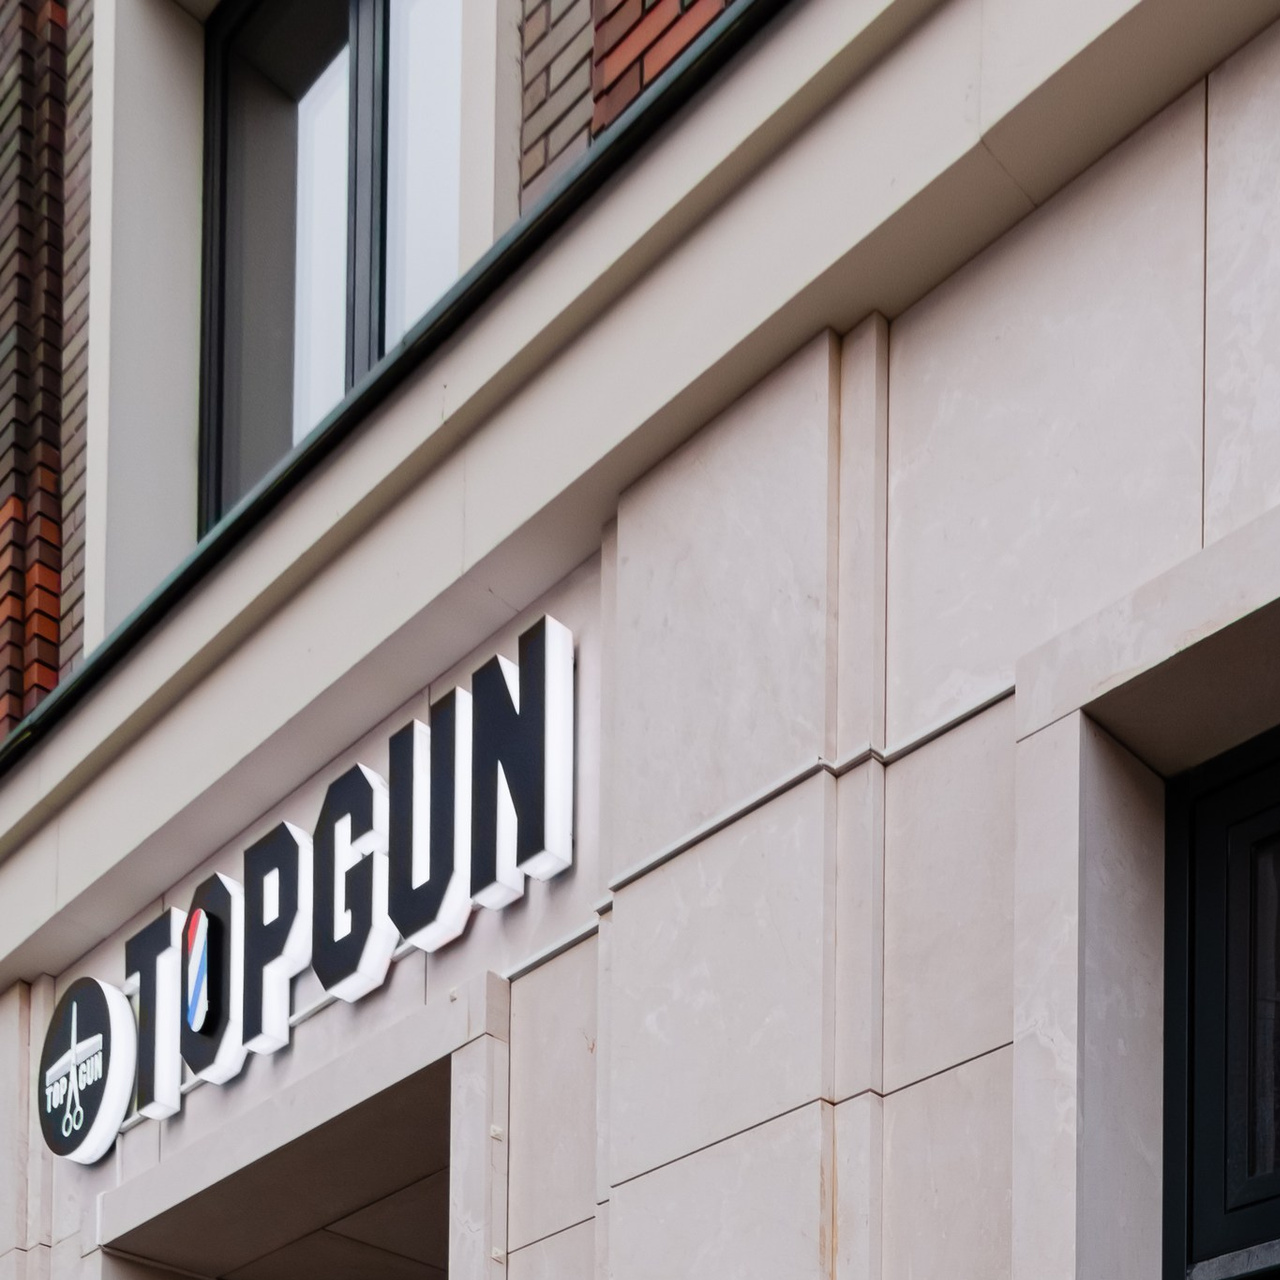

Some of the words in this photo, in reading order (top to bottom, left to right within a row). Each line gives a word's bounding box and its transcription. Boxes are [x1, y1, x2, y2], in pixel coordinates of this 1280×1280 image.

[125, 613, 574, 1120] TOPGUN
[45, 1075, 68, 1114] TOP
[78, 1050, 103, 1091] GUN
